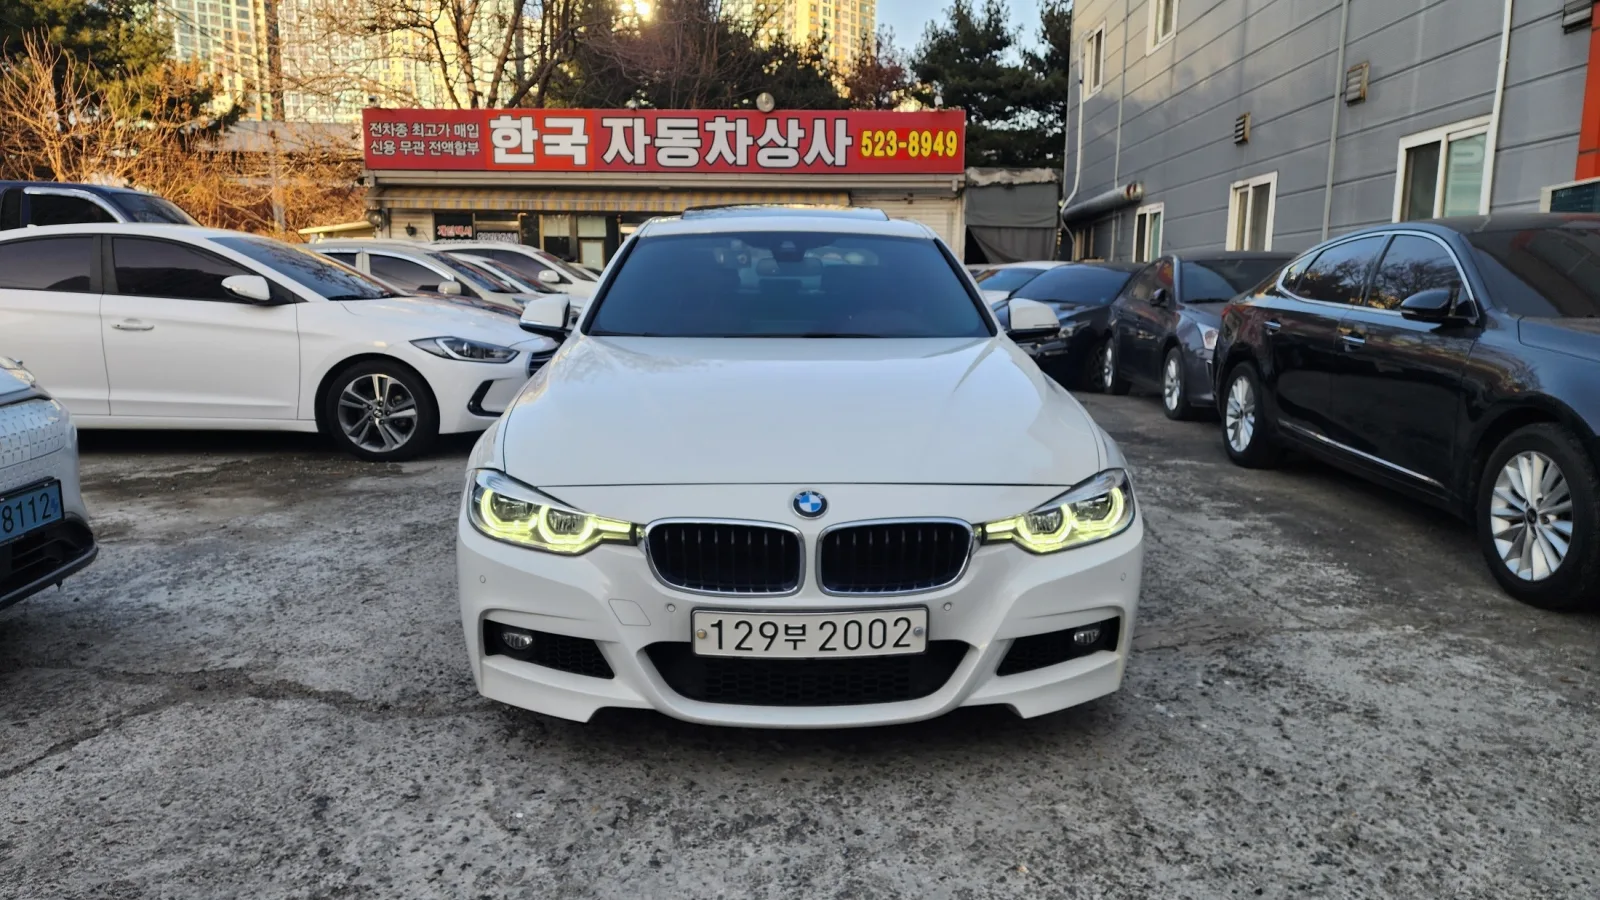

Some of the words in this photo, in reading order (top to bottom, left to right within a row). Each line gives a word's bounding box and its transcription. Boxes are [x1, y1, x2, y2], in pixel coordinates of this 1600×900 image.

[369, 122, 408, 138] 전차종
[411, 122, 451, 138] 최고가
[453, 122, 479, 139] 매입
[488, 115, 589, 166] 한국
[601, 115, 853, 168] 자동차상사
[860, 130, 958, 158] 523-8949
[370, 140, 396, 156] 신용
[399, 140, 426, 156] 무관
[428, 140, 480, 156] 전액할부
[1, 492, 52, 534] 8112
[710, 619, 807, 652] 129부
[818, 616, 912, 652] 2002
